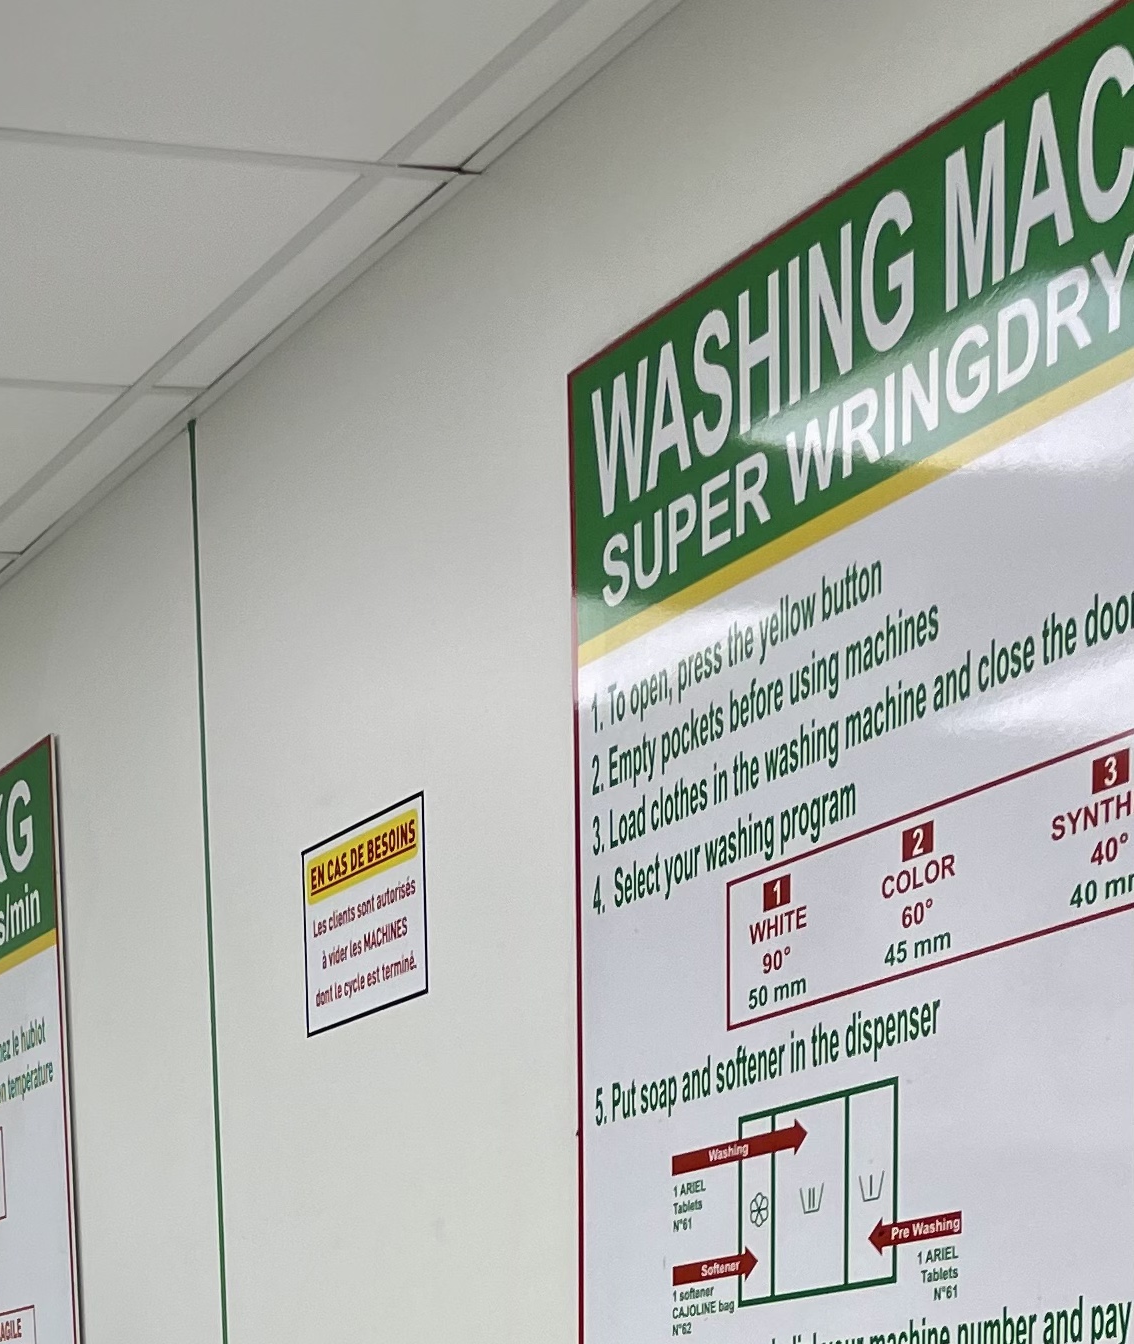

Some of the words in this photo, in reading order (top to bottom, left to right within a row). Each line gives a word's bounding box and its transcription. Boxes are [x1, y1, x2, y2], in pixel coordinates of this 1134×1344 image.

[591, 190, 914, 517] WASHING
[945, 45, 1134, 311] MAC
[602, 452, 770, 608] SUPER
[786, 235, 1134, 505] WRINGDRY
[592, 693, 603, 733] 1.
[608, 684, 625, 725] To
[631, 668, 672, 722] open,
[678, 641, 722, 694] press
[728, 621, 754, 667] the
[760, 593, 815, 664] yellow
[822, 560, 882, 621] button
[592, 755, 604, 795] 2.
[610, 732, 655, 787] Empty
[662, 702, 723, 775] pockets
[730, 678, 783, 732] before
[790, 649, 839, 705] using
[846, 604, 939, 679] machines
[593, 816, 604, 855] 3.
[610, 795, 646, 849] Load
[651, 778, 707, 831] clothes
[714, 763, 728, 805] in
[734, 751, 759, 796] the
[766, 719, 839, 782] washing
[846, 680, 926, 749] machine
[934, 650, 971, 712] and
[979, 639, 1035, 692] close
[1042, 612, 1077, 665] the
[1104, 756, 1117, 786] 3
[1052, 791, 1131, 841] SYNTH
[311, 863, 324, 890] EN
[328, 852, 347, 882] CAS
[350, 844, 364, 870] DE
[367, 819, 415, 863] BESOINS
[593, 876, 605, 914] 4.
[614, 852, 660, 907] Select
[665, 845, 700, 900] your
[706, 813, 773, 872] washing
[781, 783, 855, 854] program
[912, 829, 923, 856] 2
[1091, 832, 1128, 865] 40°
[773, 879, 781, 905] 1
[882, 855, 955, 899] COLOR
[313, 917, 326, 938] Les
[329, 906, 355, 930] clients
[357, 895, 375, 917] sont
[377, 876, 415, 910] autorisés
[1070, 880, 1097, 908] 40
[749, 906, 807, 944] WHITE
[902, 899, 933, 928] 60°
[322, 950, 327, 969] à
[329, 944, 348, 966] vider
[350, 940, 362, 957] les
[364, 917, 408, 950] MACHINES
[884, 941, 907, 966] 45
[914, 932, 951, 959] mm
[762, 947, 790, 974] 90°
[316, 987, 333, 1007] dont
[335, 982, 342, 1000] le
[344, 972, 364, 998] cycle
[367, 966, 380, 986] est
[382, 950, 417, 981] terminé.
[749, 986, 767, 1010] 50
[774, 978, 806, 1002] mm
[596, 1087, 607, 1126] 5.
[612, 1079, 637, 1121] Put
[641, 1072, 676, 1117] soap
[682, 1055, 710, 1102] and
[716, 1045, 785, 1093] softener
[791, 1031, 806, 1073] in
[812, 1023, 839, 1067] the
[846, 999, 940, 1062] dispenser
[709, 1144, 748, 1162] Washing
[674, 1186, 677, 1197] 1
[680, 1180, 706, 1195] ARIEL
[674, 1199, 702, 1215] Tablets
[891, 1225, 909, 1240] Pre
[912, 1217, 960, 1237] Washing
[701, 1261, 740, 1277] Softener
[917, 1251, 922, 1264] 1
[926, 1246, 958, 1263] ARIEL
[921, 1267, 958, 1283] Tablets
[673, 1291, 677, 1302] 1
[680, 1286, 714, 1301] softener
[673, 1301, 716, 1319] CAJOLINE
[719, 1299, 734, 1313] bag
[933, 1285, 958, 1301] N°61
